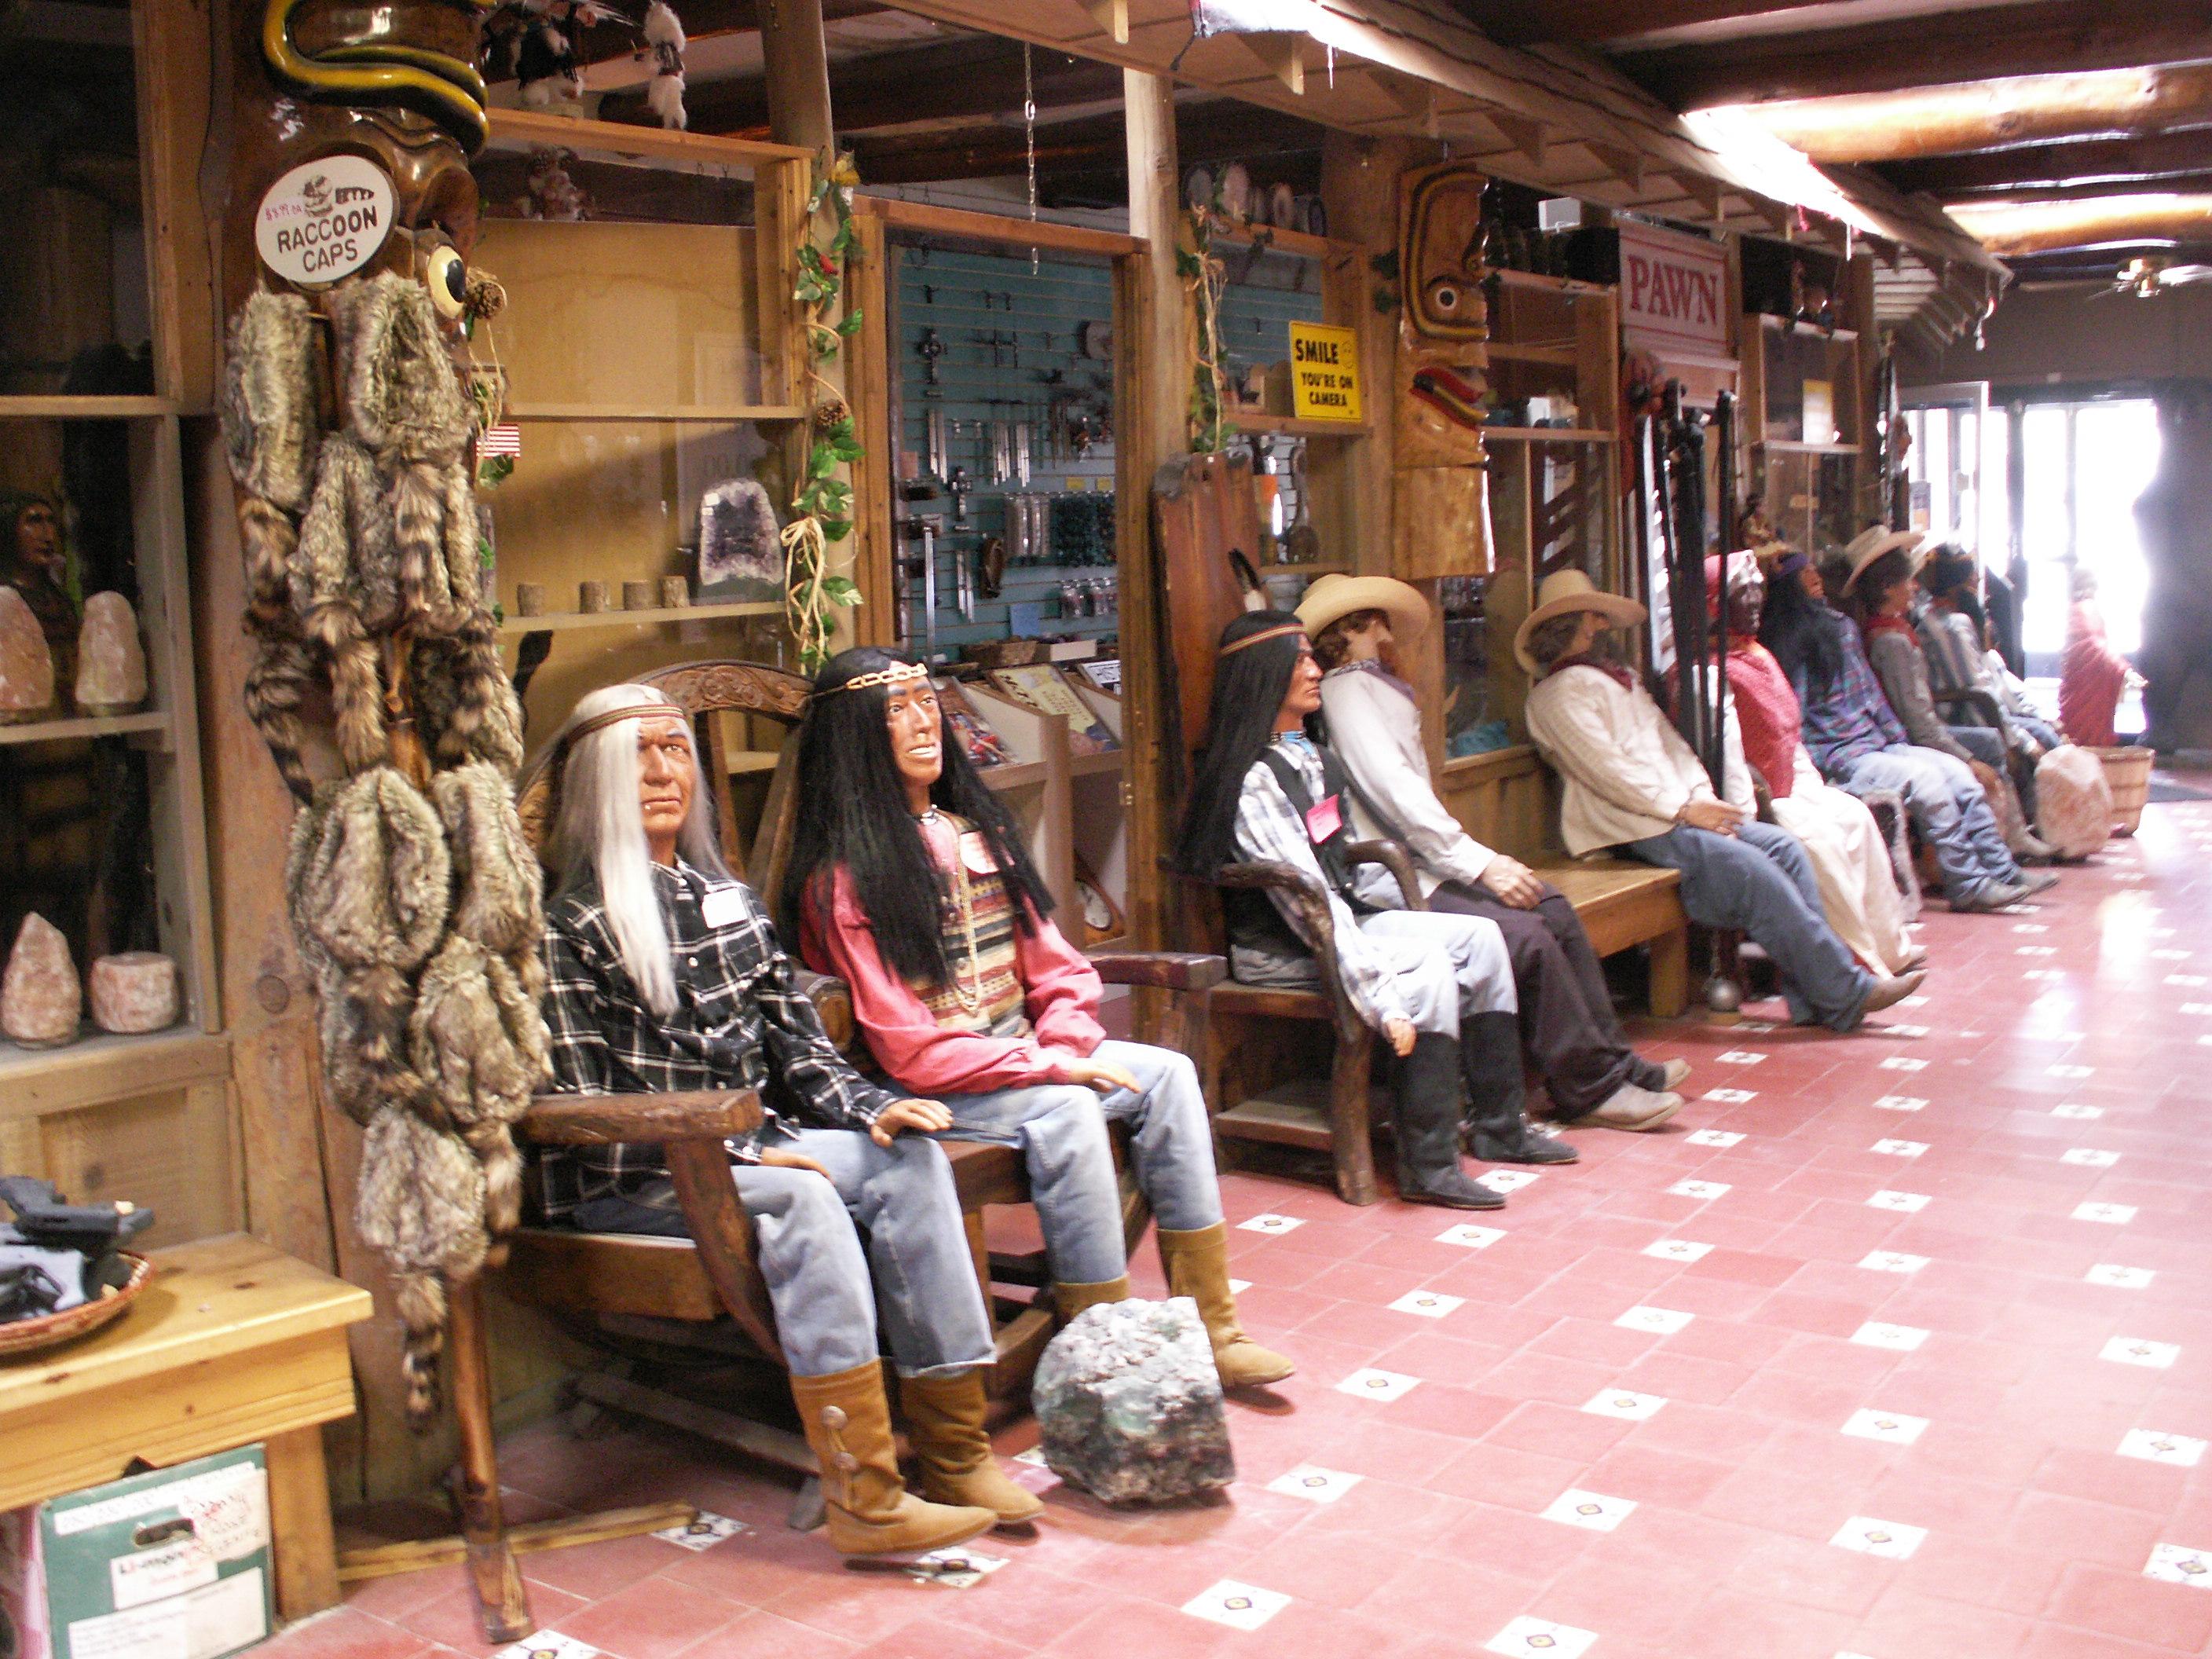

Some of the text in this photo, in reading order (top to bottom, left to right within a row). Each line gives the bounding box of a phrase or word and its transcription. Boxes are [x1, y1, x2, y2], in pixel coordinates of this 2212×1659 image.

[277, 205, 378, 253] RACCOON
[302, 239, 358, 273] CAPS
[1628, 254, 1717, 327] PAWN
[1295, 339, 1339, 364] SMILE
[1301, 372, 1353, 389] YOU'RE ON
[1309, 391, 1347, 406] CAMERA
